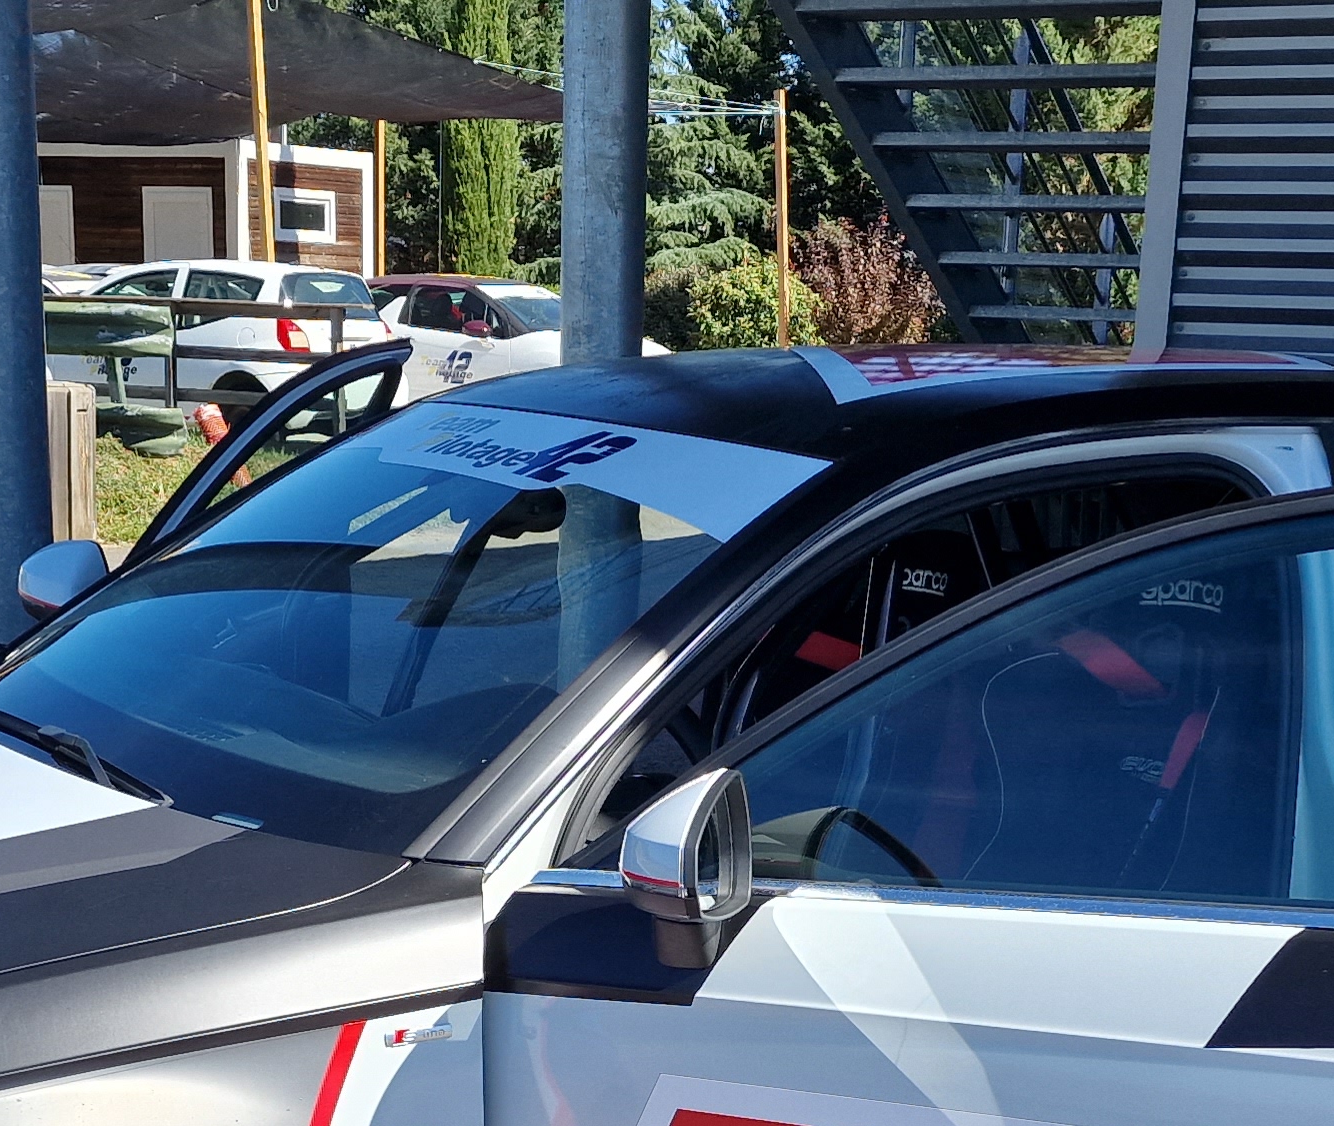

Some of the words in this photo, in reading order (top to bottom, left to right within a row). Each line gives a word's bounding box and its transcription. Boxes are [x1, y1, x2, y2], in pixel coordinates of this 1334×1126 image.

[443, 349, 473, 383] 42
[418, 411, 502, 434] Team
[414, 431, 538, 468] Pilotage
[511, 430, 638, 483] 42
